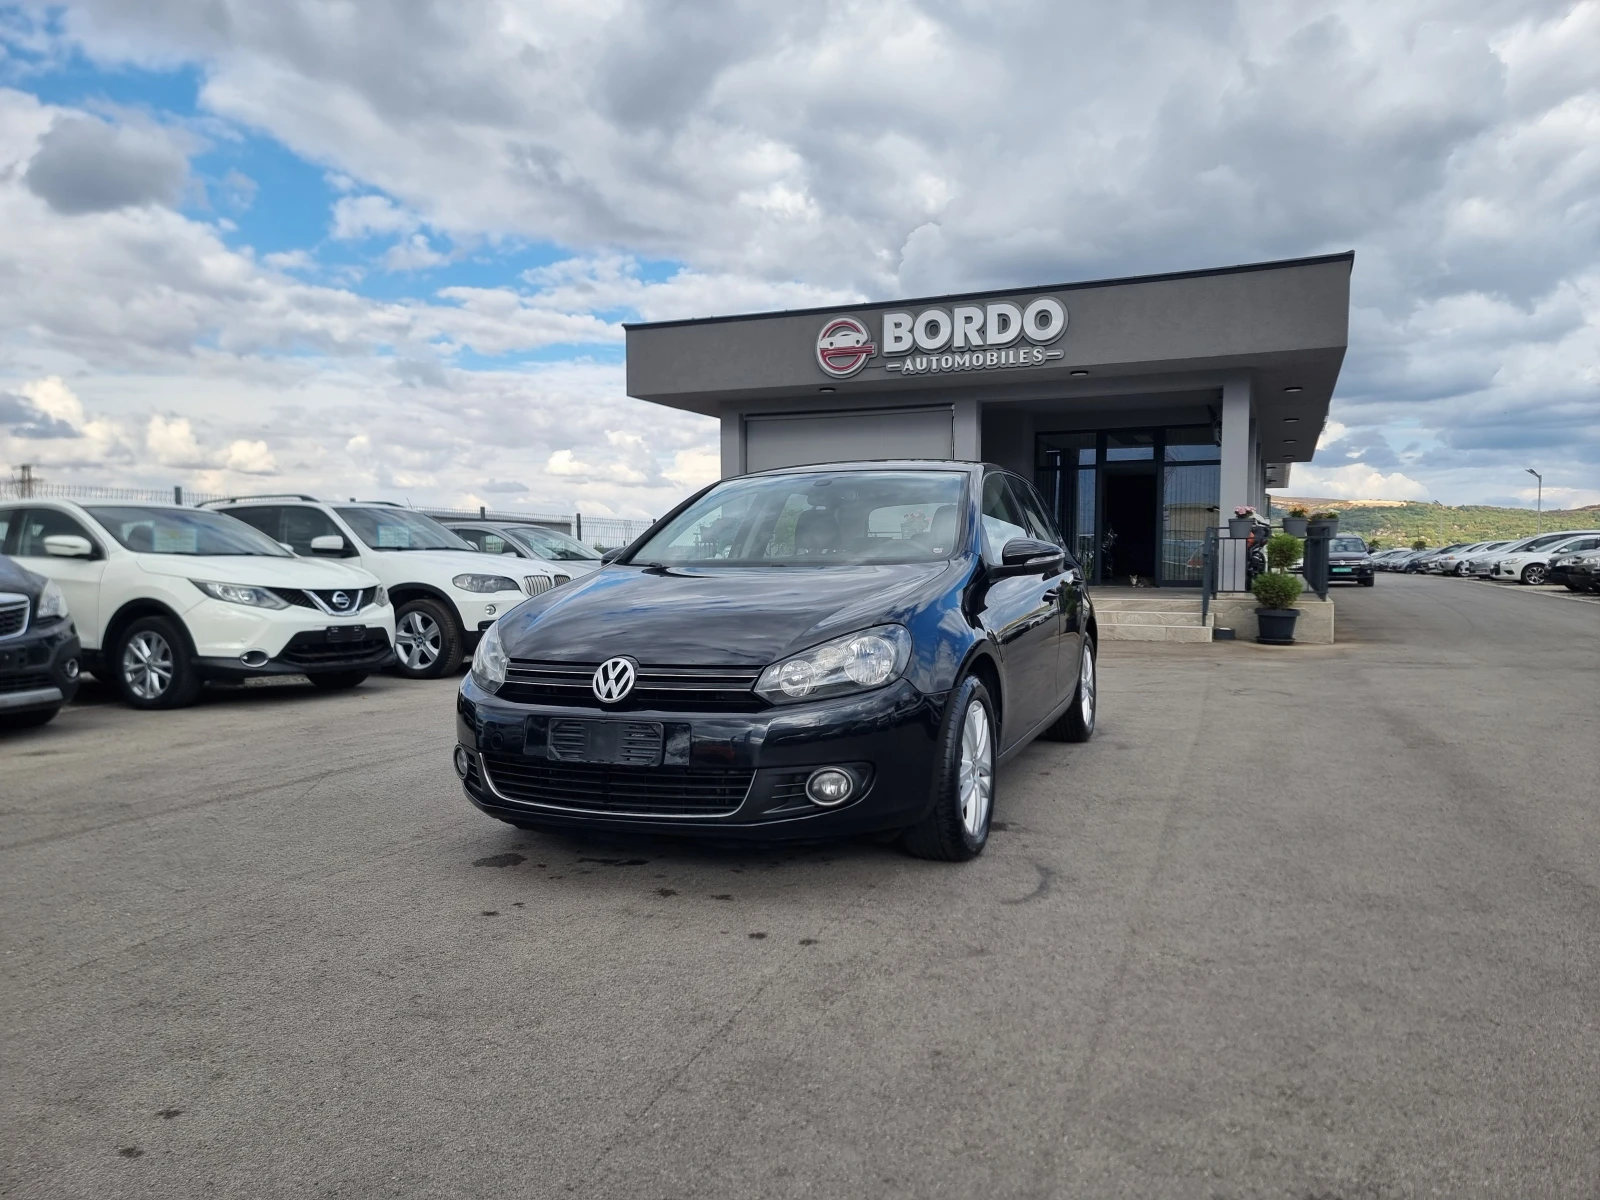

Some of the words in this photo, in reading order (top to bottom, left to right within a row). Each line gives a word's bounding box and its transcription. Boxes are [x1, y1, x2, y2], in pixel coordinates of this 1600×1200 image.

[882, 299, 1065, 353] BORDO
[903, 348, 1044, 372] AUTOMOBILES
[594, 658, 634, 701] VW
